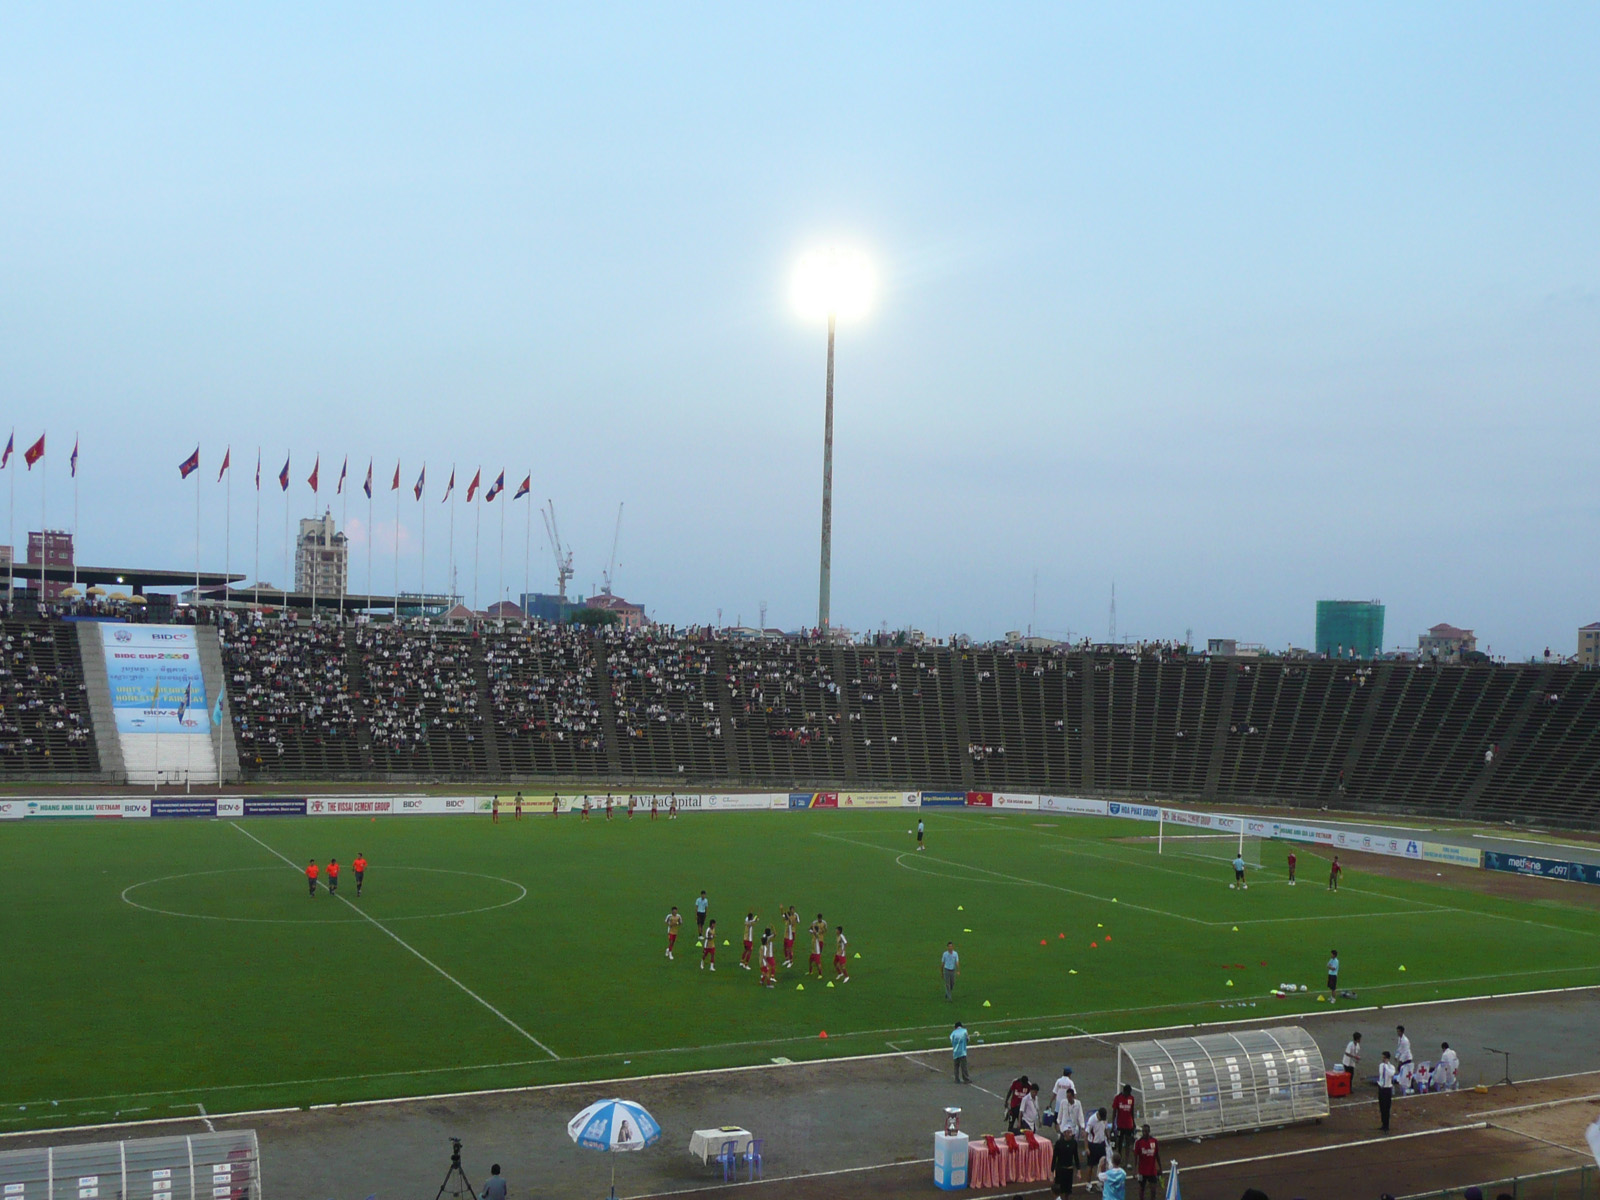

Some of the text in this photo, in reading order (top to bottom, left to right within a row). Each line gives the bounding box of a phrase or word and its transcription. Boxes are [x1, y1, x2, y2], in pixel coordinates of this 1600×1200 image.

[125, 804, 141, 812] BIDV
[328, 802, 390, 811] THE VISSAI CEMENT GROUP
[640, 796, 702, 809] ViaCpital
[1121, 805, 1158, 817] HOA PHAT GROUP
[1508, 858, 1541, 870] metfone
[1554, 865, 1568, 876] 097
